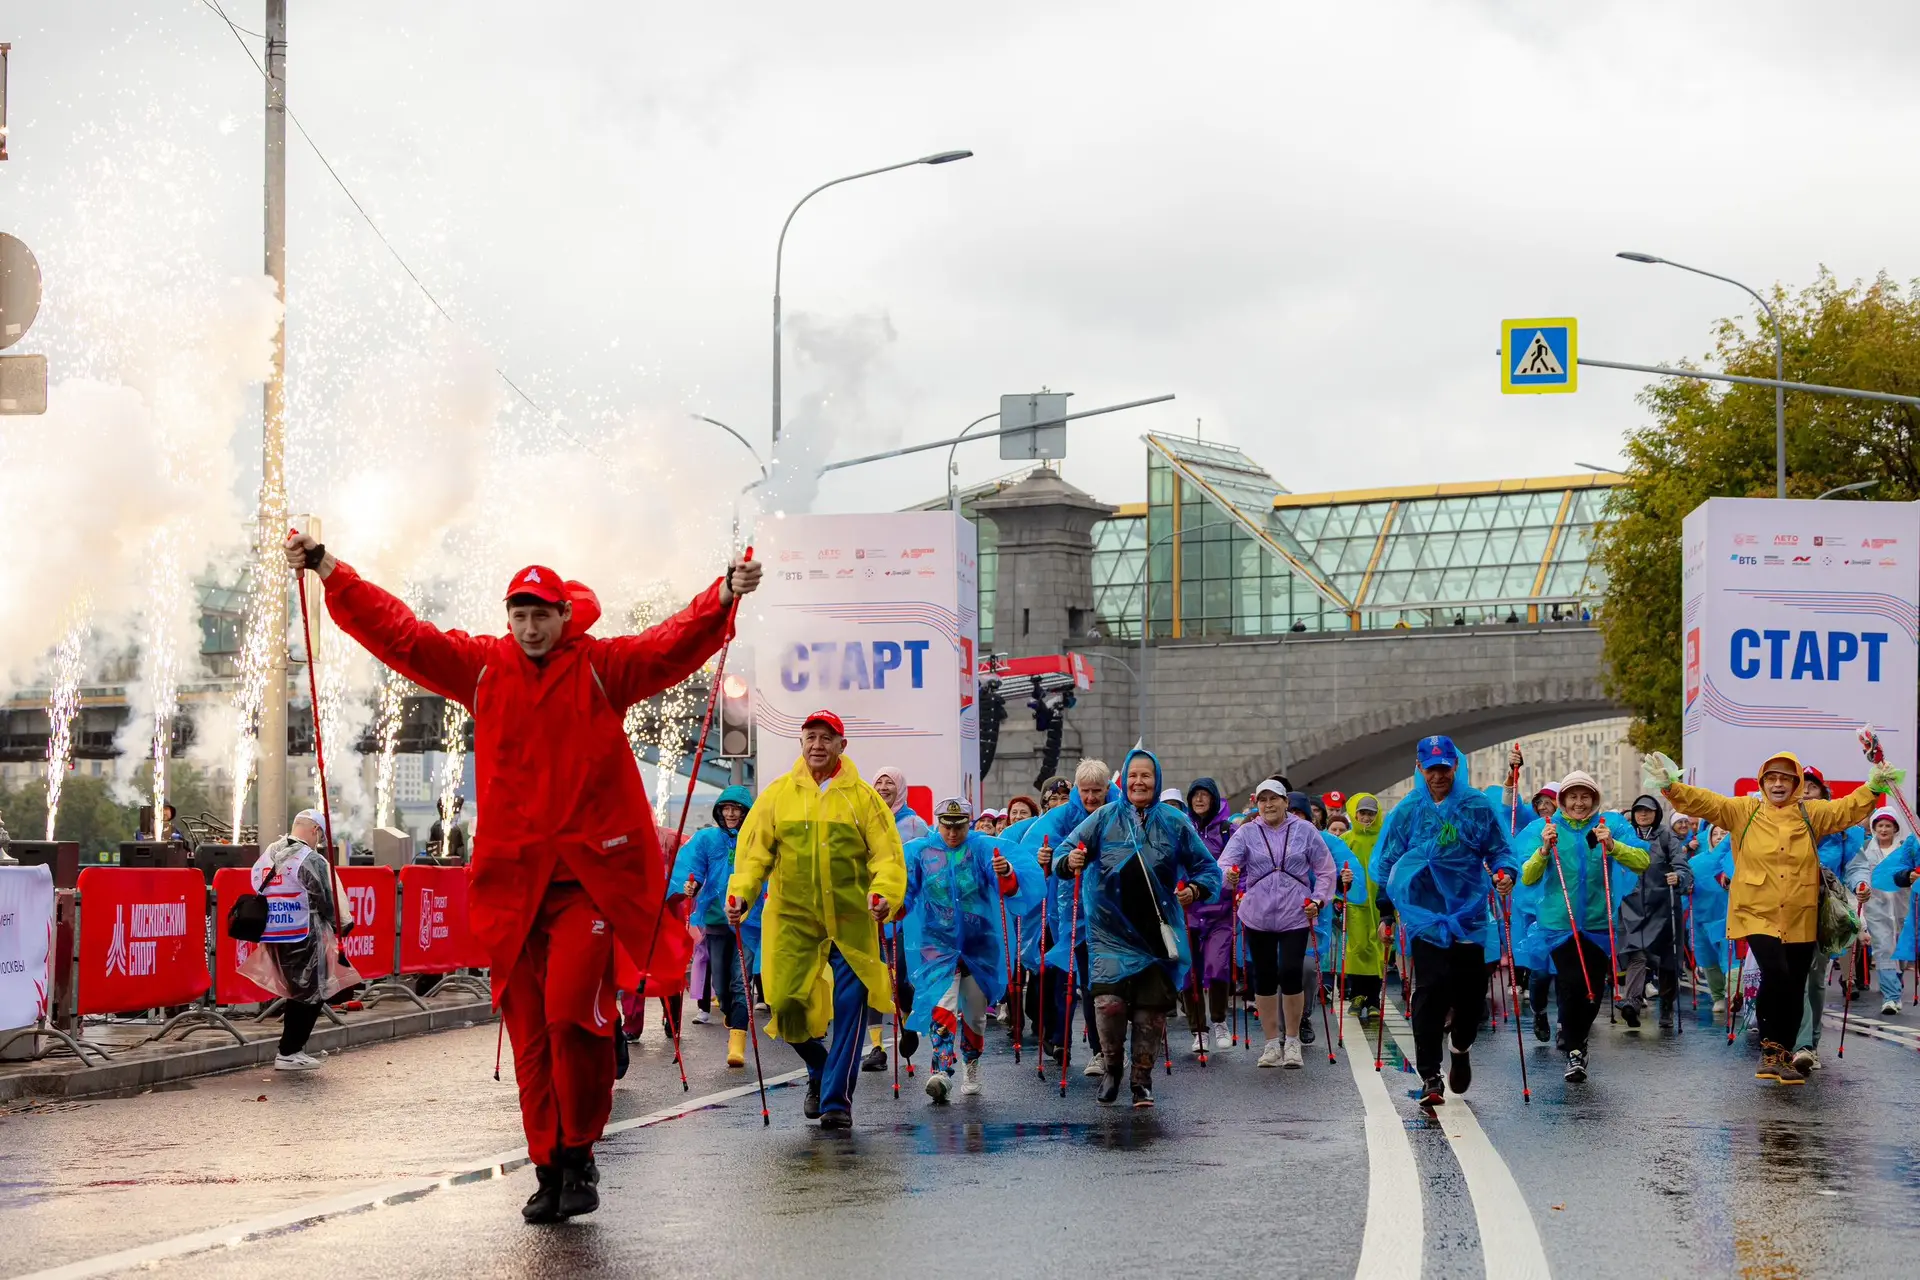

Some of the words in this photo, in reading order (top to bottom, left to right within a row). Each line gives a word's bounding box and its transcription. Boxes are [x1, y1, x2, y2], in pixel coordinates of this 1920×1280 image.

[1739, 556, 1757, 565] ВТБ
[785, 571, 803, 581] ВТБ
[780, 640, 929, 692] СТАРТ
[1730, 628, 1888, 682] СТАРТ
[130, 895, 187, 938] МОСКОВСКИЙ
[266, 913, 294, 924] РОЛЬ
[267, 901, 301, 912] ЧЕСКИЙ
[346, 886, 375, 926] ЕТО
[0, 960, 26, 975] осквы
[129, 941, 157, 977] СПОРТ
